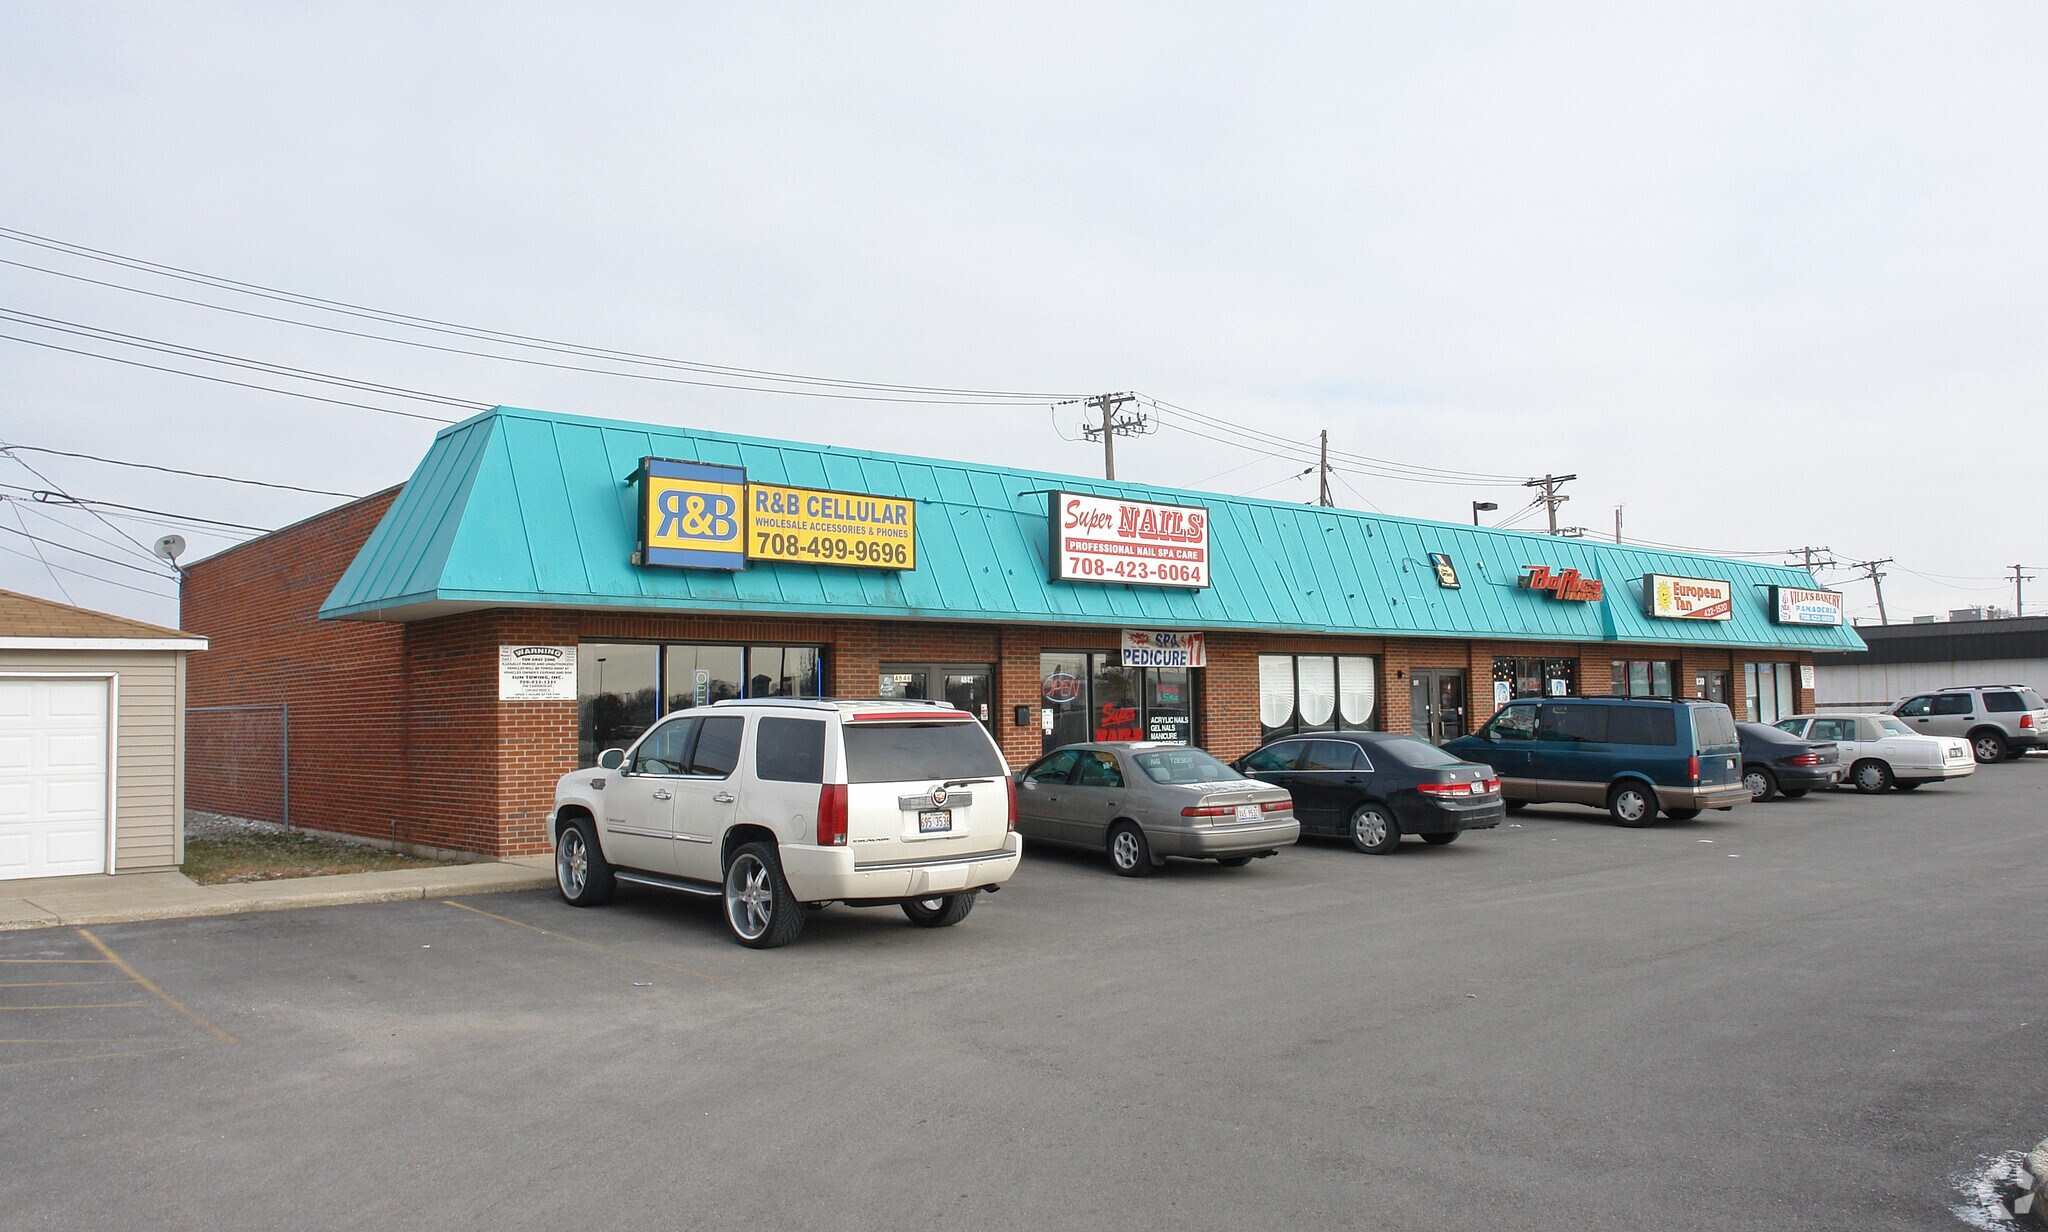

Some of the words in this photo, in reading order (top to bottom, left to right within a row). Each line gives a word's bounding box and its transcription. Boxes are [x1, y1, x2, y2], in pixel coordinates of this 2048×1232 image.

[654, 488, 738, 543] R&B
[755, 490, 800, 515] R&B
[806, 496, 908, 526] CELLULAR
[755, 517, 808, 530] WHOLESALE
[809, 521, 866, 535] ACCESSORIES
[868, 527, 875, 536] &
[876, 527, 909, 539] PHONES
[1065, 499, 1113, 536] Super
[1117, 505, 1205, 544] NAILS
[756, 532, 908, 565] 708-499-9696
[1069, 540, 1135, 555] PROFESSIONAL
[1136, 546, 1156, 557] NAIL
[1158, 549, 1174, 558] SPA
[1176, 550, 1199, 560] CARE
[1069, 557, 1201, 582] 708-423-6064
[1673, 582, 1722, 601] European
[1790, 591, 1815, 605] VILLA'S
[1815, 593, 1841, 609] BAKERY
[1673, 596, 1693, 611] Tan
[1703, 602, 1728, 617] 422-1520
[1795, 605, 1837, 614] PANADERIA
[1155, 633, 1180, 648] SPA
[514, 648, 562, 658] WARNING
[1123, 649, 1188, 666] PEDICURE
[1041, 677, 1081, 698] OPEN
[1101, 702, 1136, 726] Super
[1150, 716, 1174, 724] ACRYLIC
[1174, 716, 1189, 724] NAILS
[1150, 724, 1161, 732] GEL
